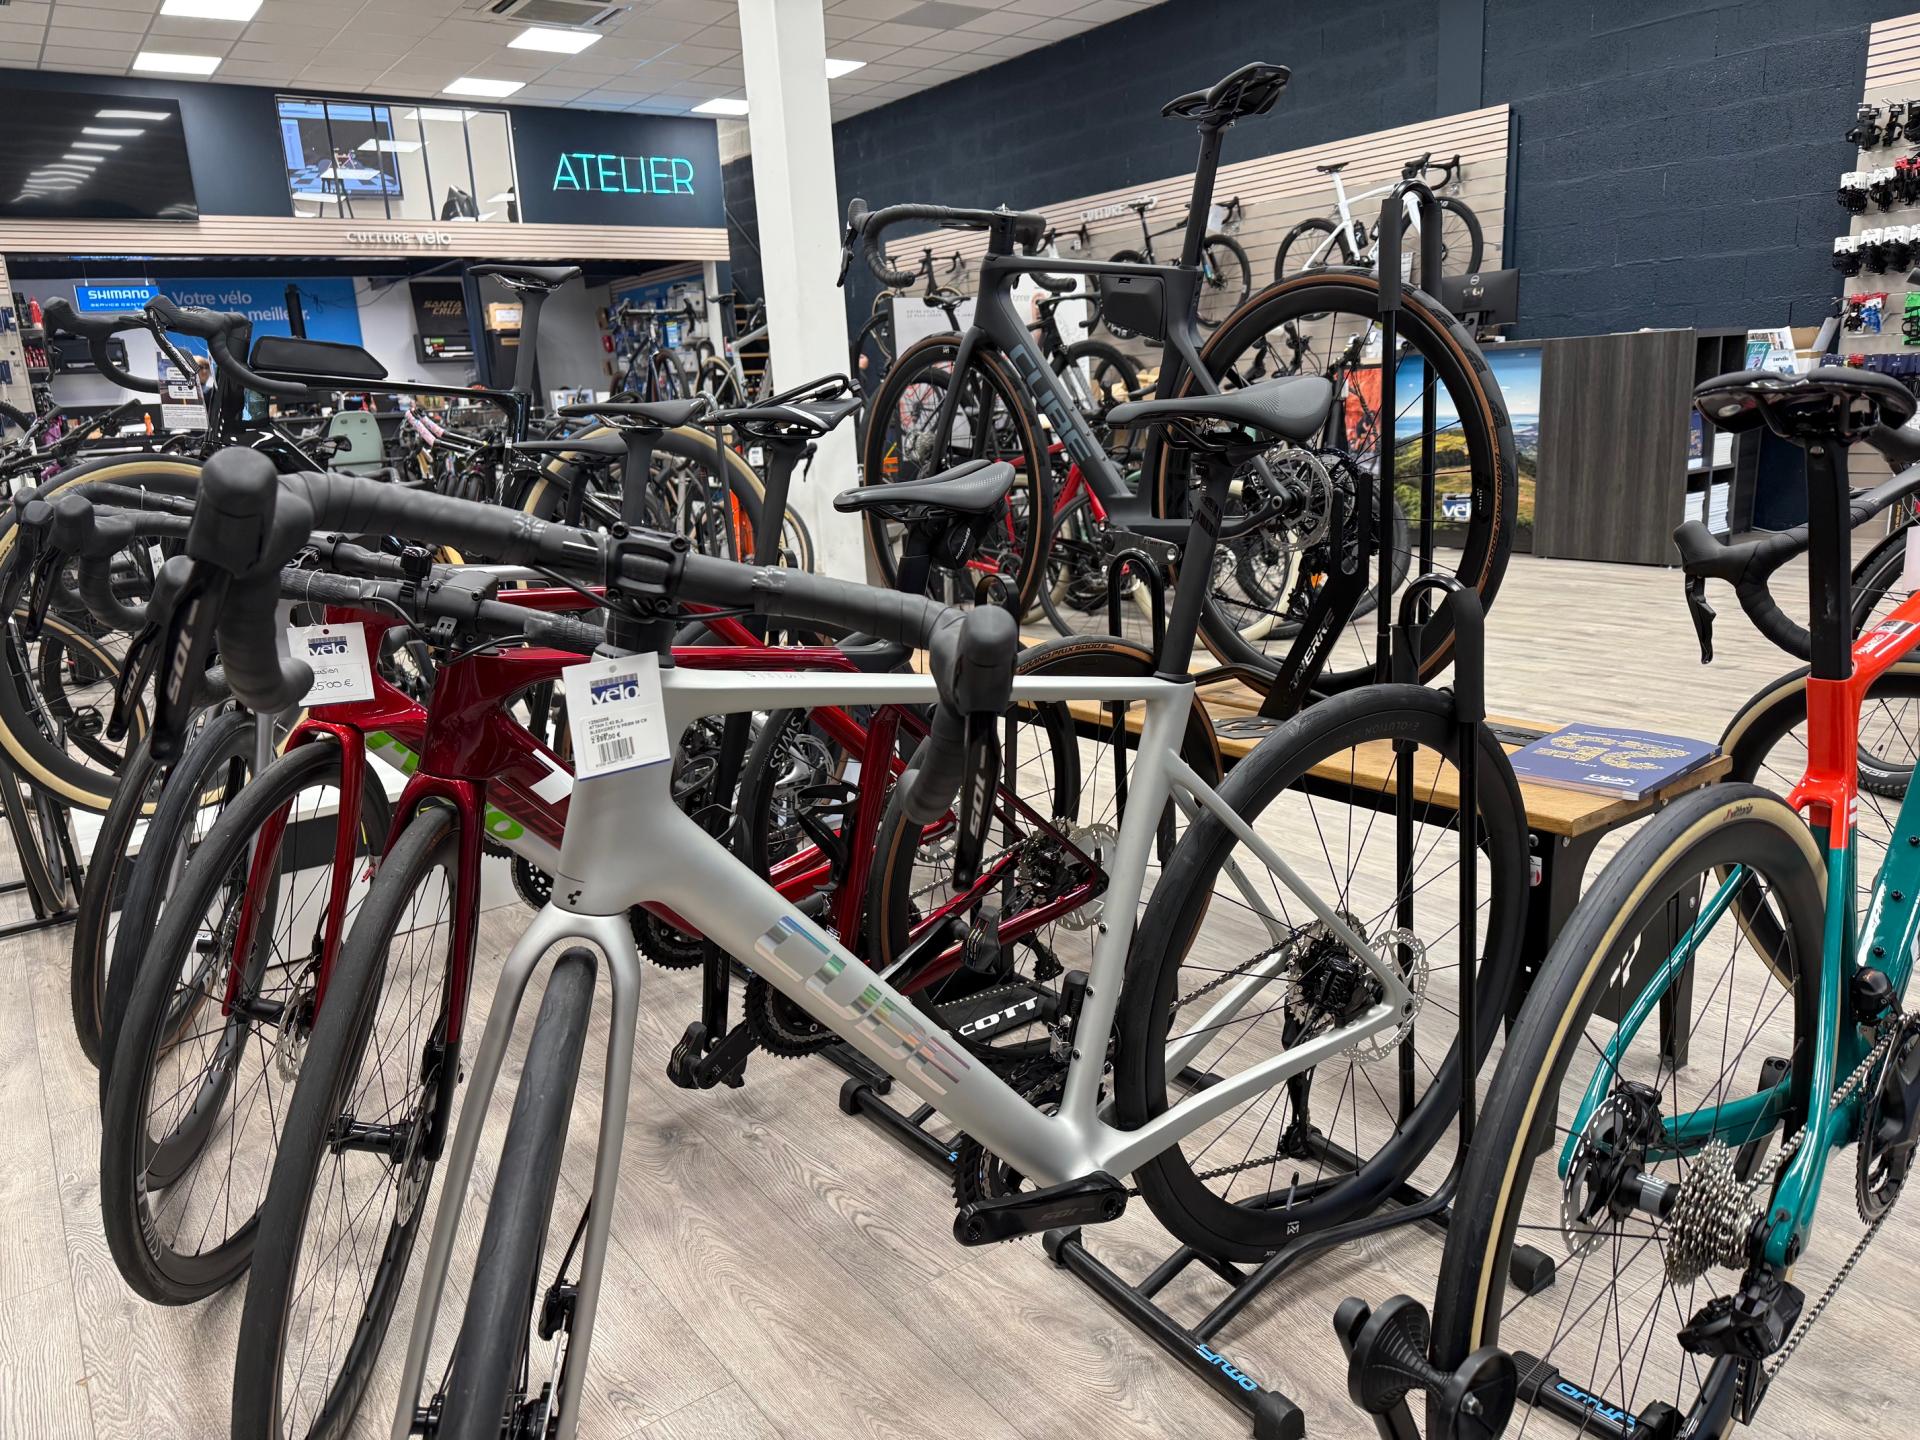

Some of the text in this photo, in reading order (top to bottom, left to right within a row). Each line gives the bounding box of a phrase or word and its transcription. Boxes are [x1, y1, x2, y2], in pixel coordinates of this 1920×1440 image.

[552, 153, 695, 195] ATELIER
[347, 231, 409, 244] CULTURE
[88, 289, 150, 300] SHIMANO
[172, 290, 252, 305] Votre vélo
[248, 306, 310, 320] meiller.
[1009, 343, 1092, 462] CUBE
[1018, 652, 1050, 672] GRAND
[1049, 645, 1074, 659] PRIX
[1074, 642, 1101, 651] 5000
[970, 774, 986, 840] 105
[754, 915, 971, 1096] CUBE
[957, 996, 1038, 1036] COTT
